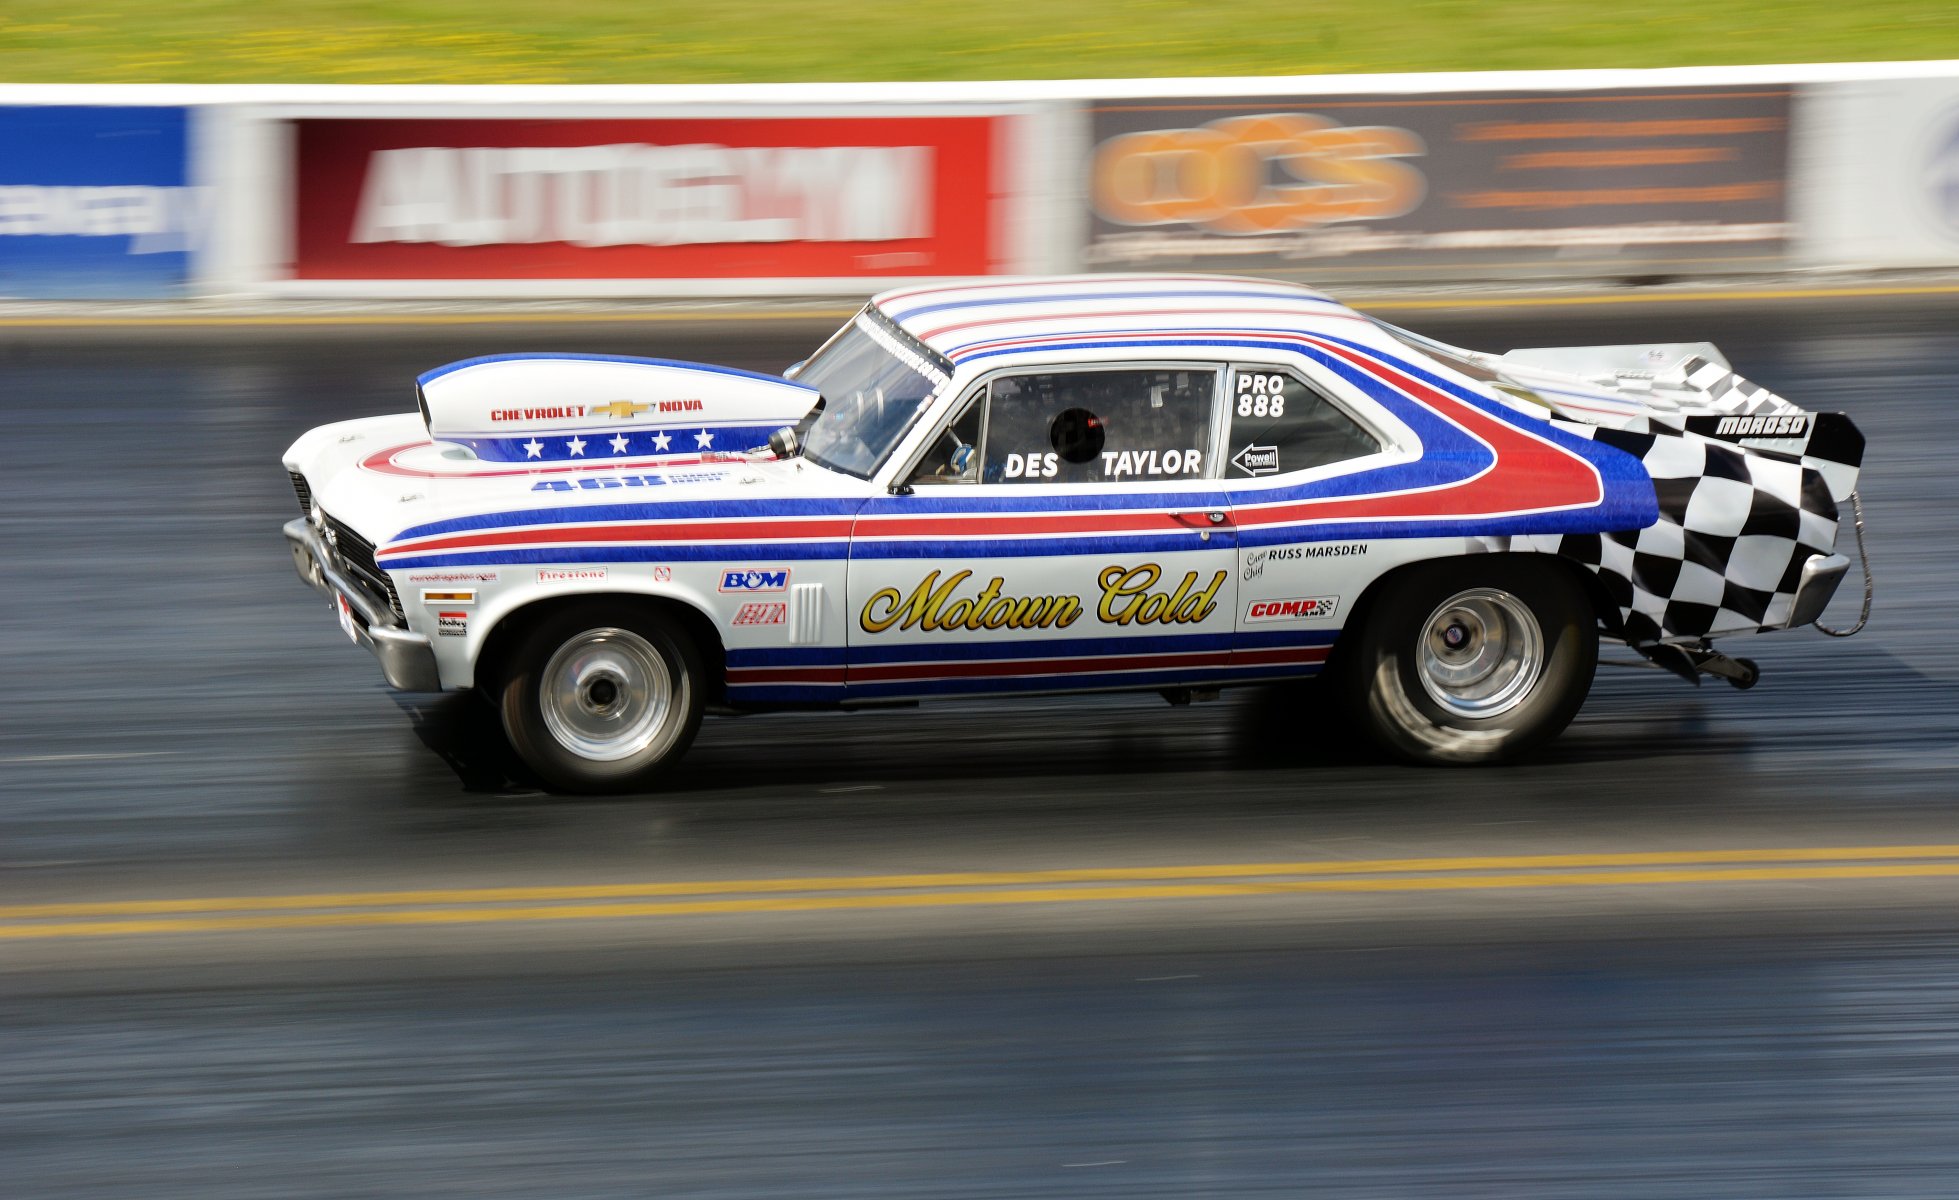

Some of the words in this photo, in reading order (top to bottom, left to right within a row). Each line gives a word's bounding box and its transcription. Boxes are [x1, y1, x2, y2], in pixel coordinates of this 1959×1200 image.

[1237, 374, 1284, 394] PRO
[491, 405, 586, 421] CHEVROLET
[659, 399, 704, 412] NOVA
[1237, 395, 1285, 417] 888
[1715, 416, 1808, 435] MOROSO
[1005, 453, 1059, 478] DES
[1101, 450, 1202, 476] TAYLOR
[1244, 452, 1276, 464] Powell
[1268, 549, 1302, 560] RUSS
[1305, 544, 1368, 558] MARSDEN
[860, 569, 1083, 633] Motown
[1097, 563, 1228, 626] Gold
[1250, 600, 1317, 617] COMP
